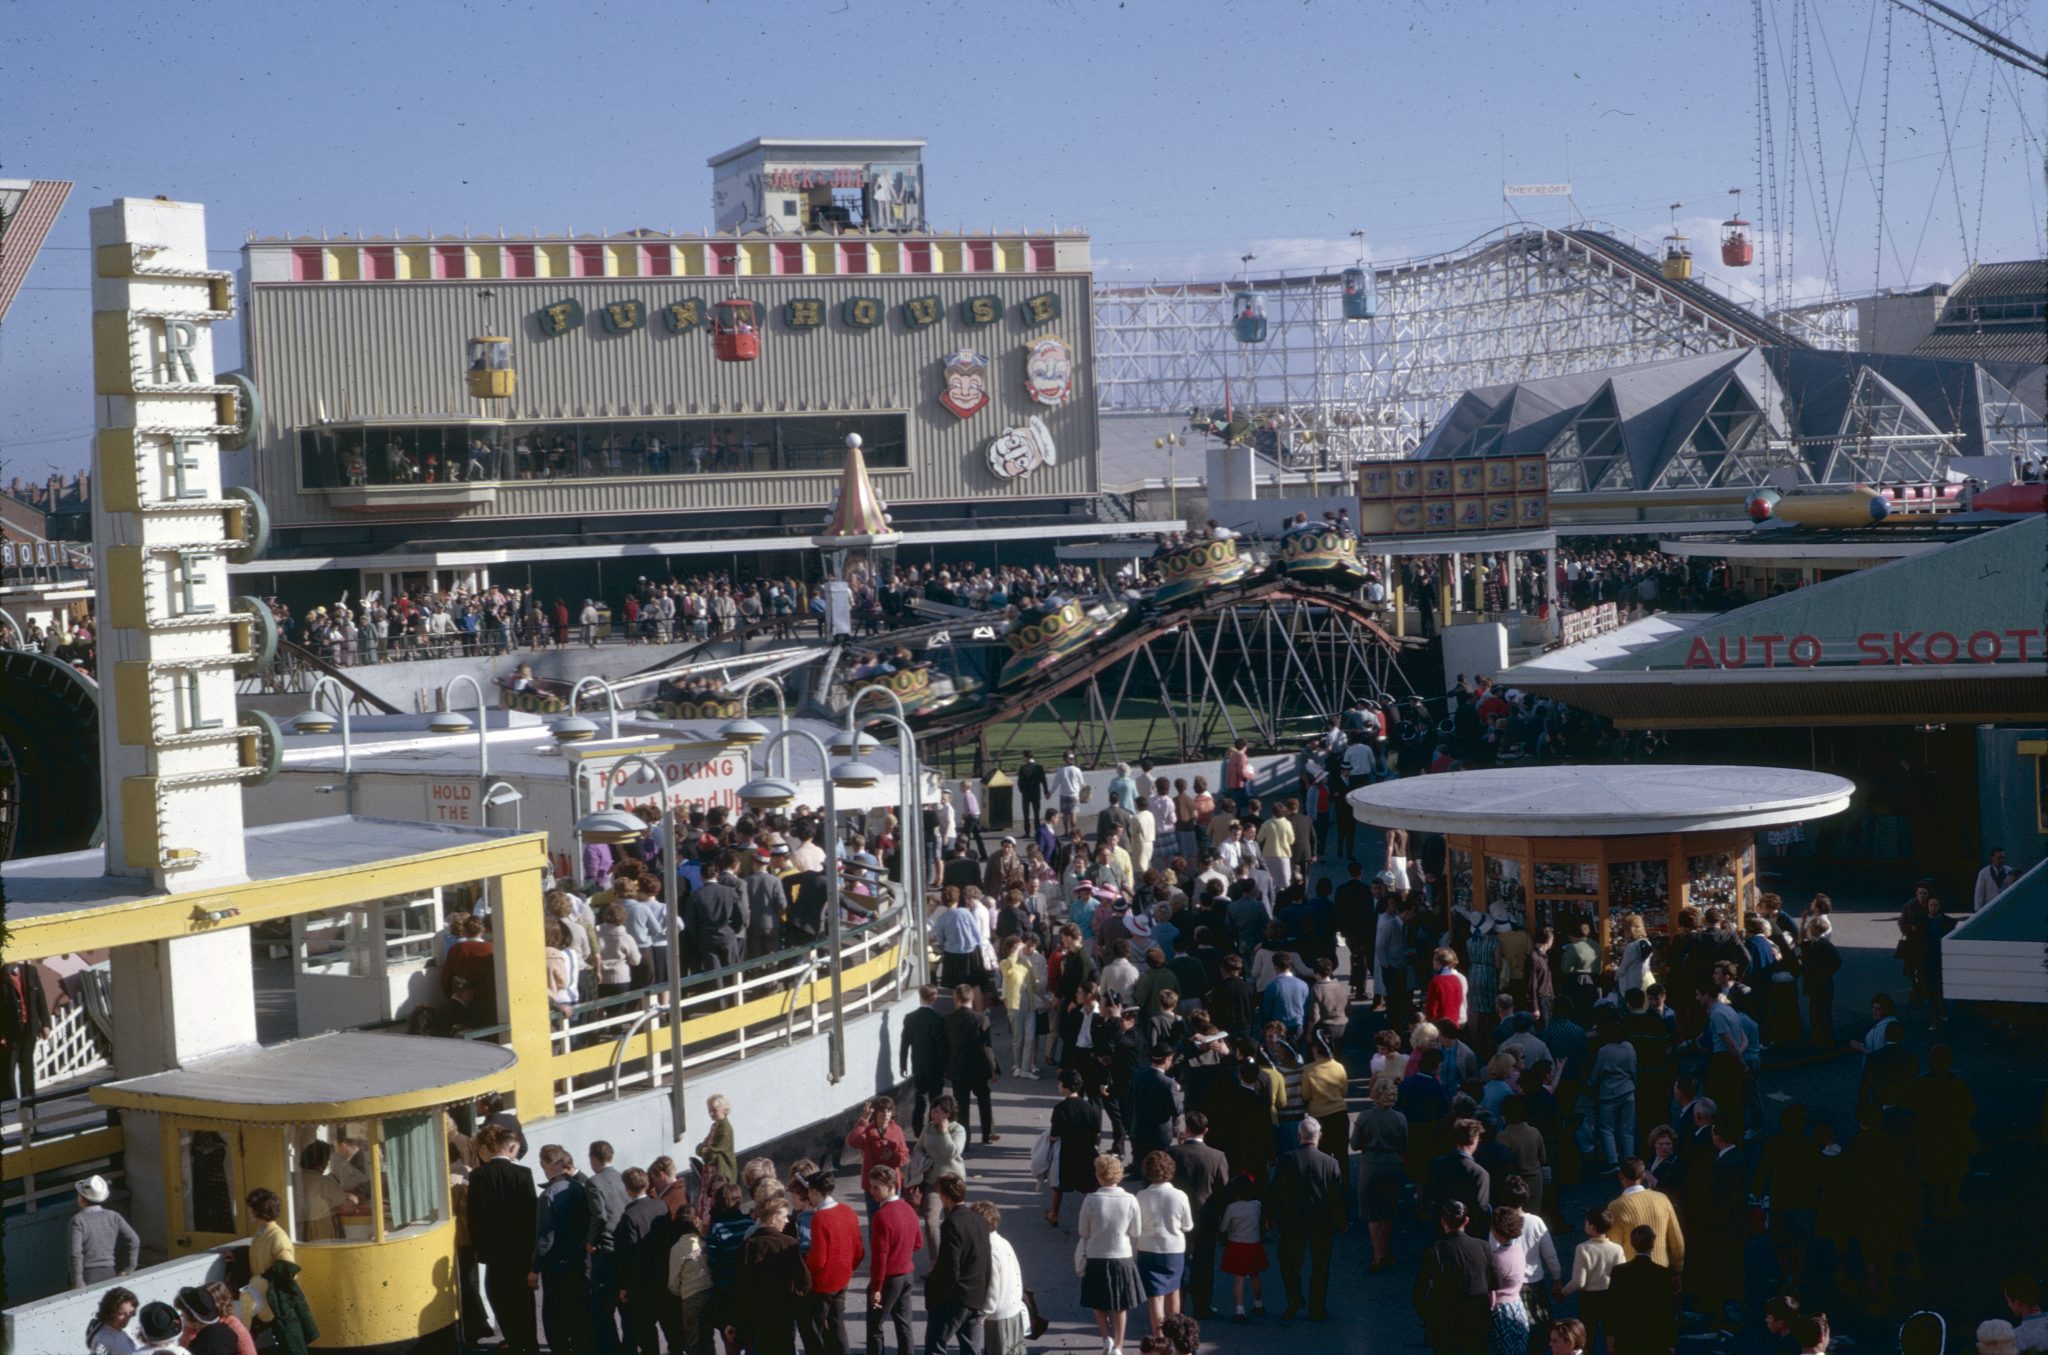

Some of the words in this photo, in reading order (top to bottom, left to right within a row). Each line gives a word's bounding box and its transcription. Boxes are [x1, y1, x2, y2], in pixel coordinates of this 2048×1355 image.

[769, 168, 815, 189] JACK
[830, 167, 865, 189] JILL
[548, 301, 698, 332] FUN
[791, 296, 1055, 325] HOUSE
[1365, 463, 1542, 494] TURTLE
[162, 319, 224, 729] REEL
[1395, 499, 1546, 526] CHASE
[3, 542, 70, 566] BOATS
[1685, 634, 1823, 670] AUTO
[1857, 628, 2040, 666] SKOOT
[636, 759, 734, 786] OKING
[432, 784, 472, 801] HOLD
[437, 805, 469, 821] THE
